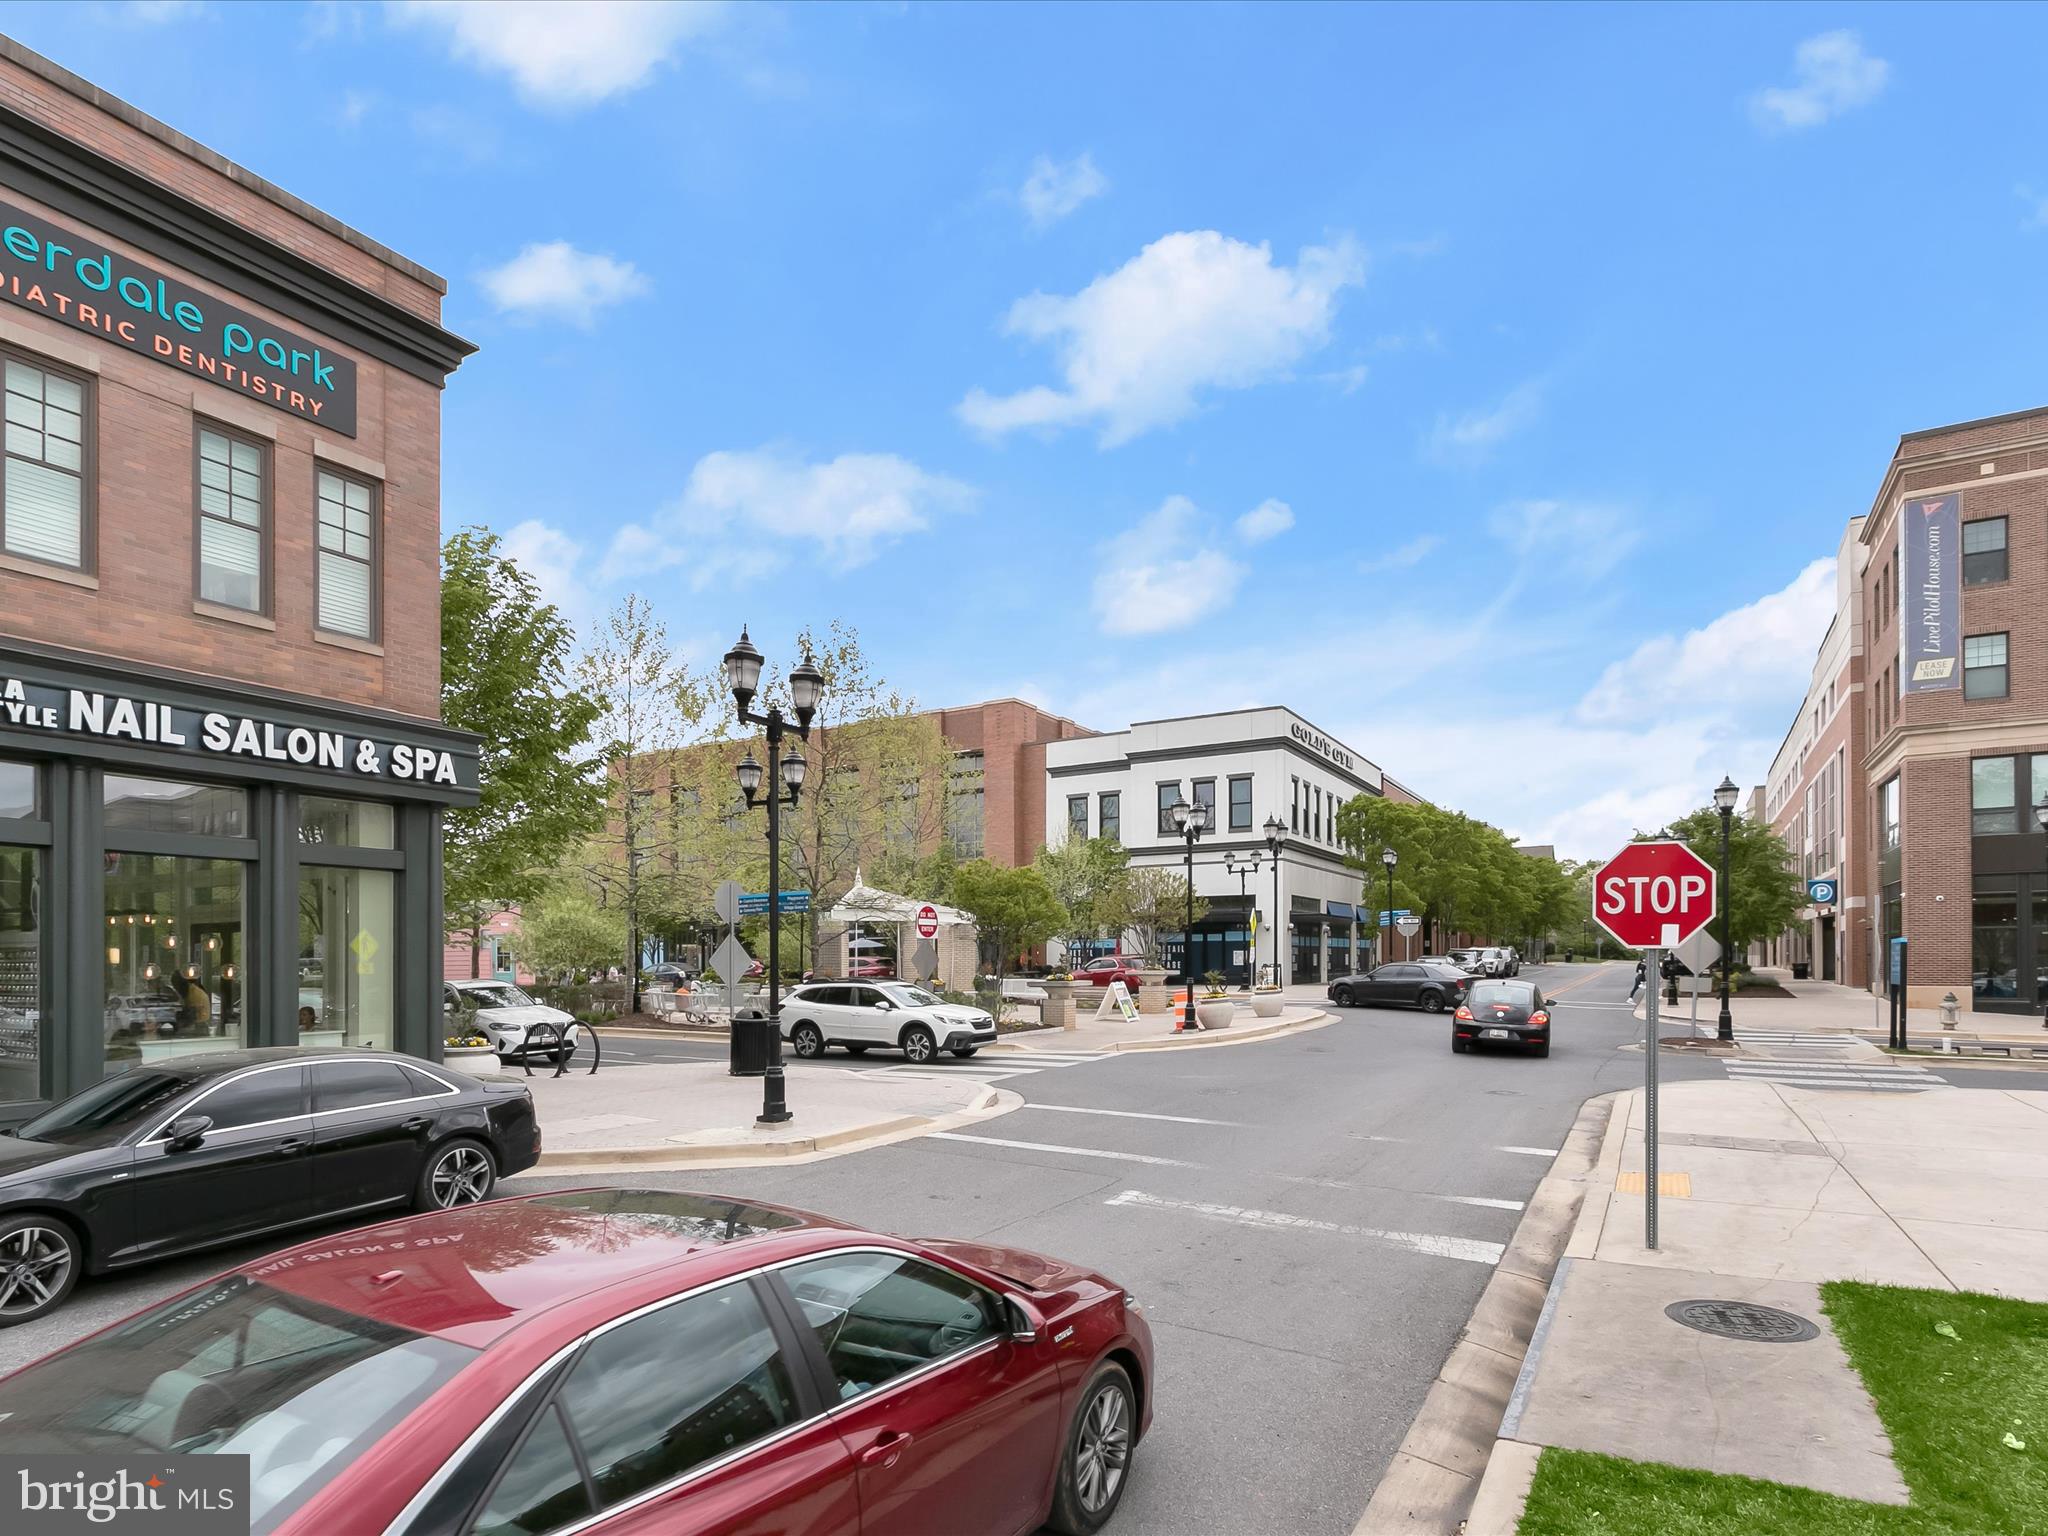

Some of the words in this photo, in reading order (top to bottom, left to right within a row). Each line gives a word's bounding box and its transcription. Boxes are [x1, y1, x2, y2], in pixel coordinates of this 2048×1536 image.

[223, 323, 334, 391] park
[153, 334, 323, 417] DENTISTRY
[1922, 525, 1941, 654] LivePilotHouse.com
[1919, 661, 1948, 671] LEASE
[1923, 669, 1945, 678] NOW
[0, 678, 26, 701] A
[0, 700, 58, 728] YLE
[69, 689, 185, 745] NAIL
[202, 713, 344, 768] SALON
[355, 738, 380, 774] &
[391, 744, 457, 785] SPA
[1332, 747, 1354, 770] GYM
[1602, 875, 1706, 915] STOP
[1816, 886, 1829, 899] P
